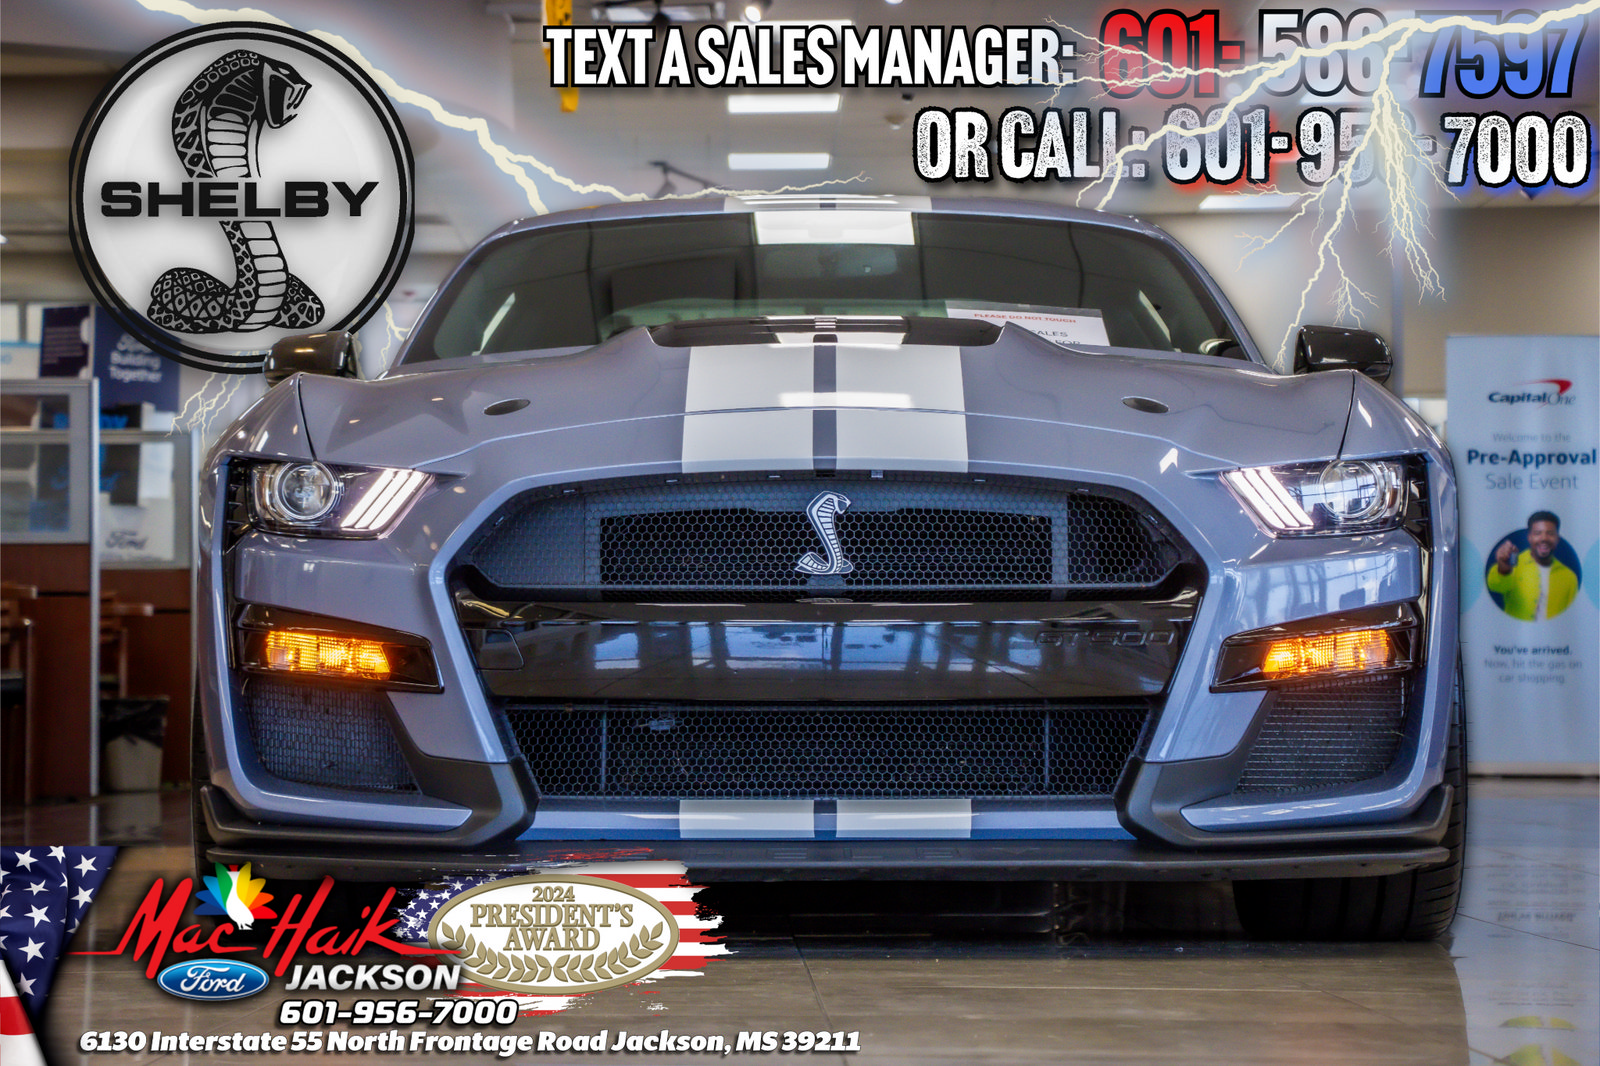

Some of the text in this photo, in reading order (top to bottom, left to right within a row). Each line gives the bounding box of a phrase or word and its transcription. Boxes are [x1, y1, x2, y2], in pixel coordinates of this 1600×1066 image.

[974, 313, 1006, 321] PLEASE
[1493, 432, 1571, 443] Welcome to the
[1467, 449, 1597, 469] Pre-Approval
[1486, 473, 1578, 490] Sale Event
[1494, 645, 1528, 656] You've
